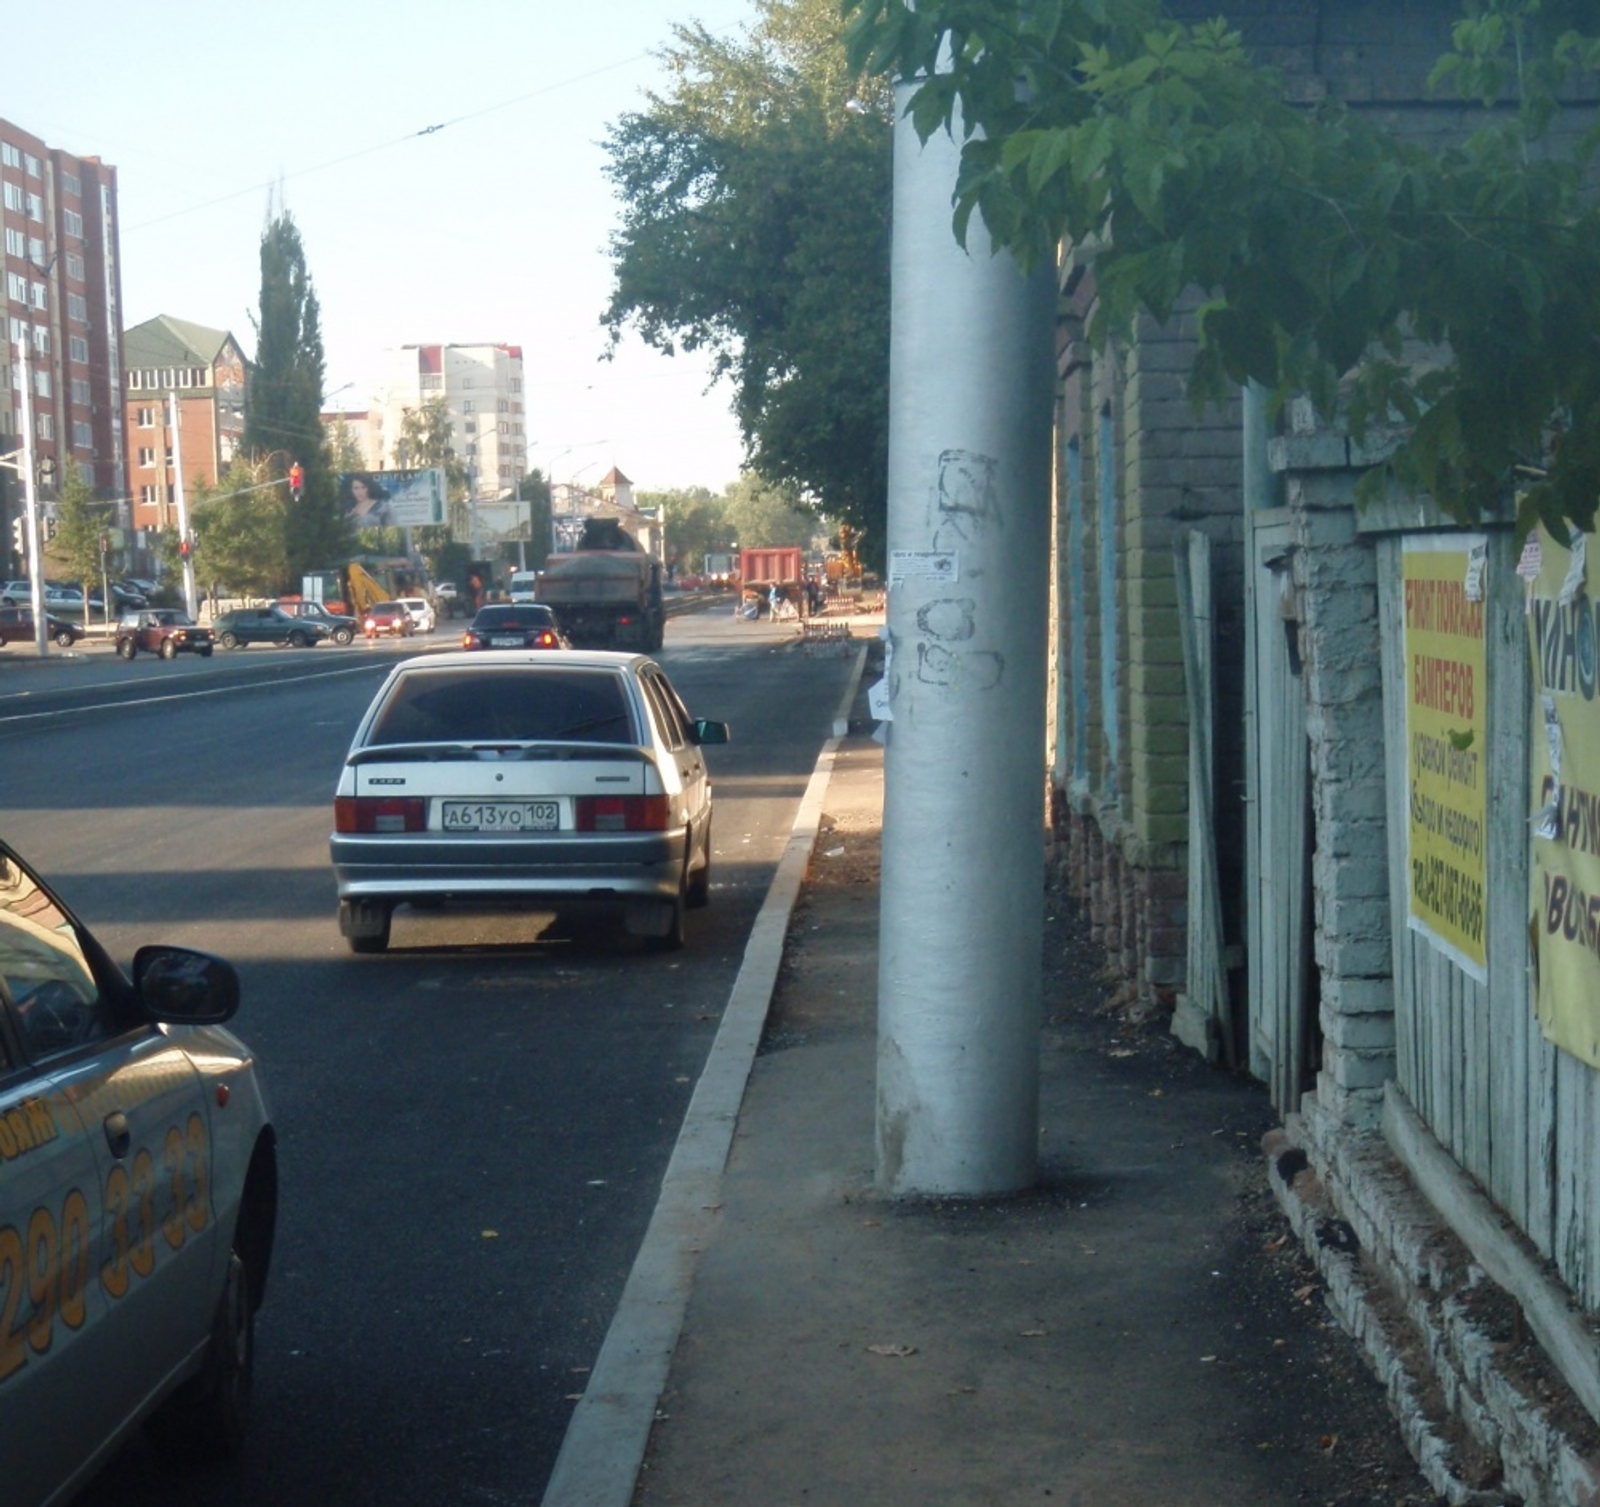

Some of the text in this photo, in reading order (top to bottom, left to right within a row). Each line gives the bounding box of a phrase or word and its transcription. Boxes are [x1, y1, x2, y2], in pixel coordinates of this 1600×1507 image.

[1405, 579, 1435, 631] РМОНТ
[1414, 654, 1474, 720] БАМПЕРОВ
[101, 1147, 154, 1298] 33
[162, 1111, 207, 1250] 33
